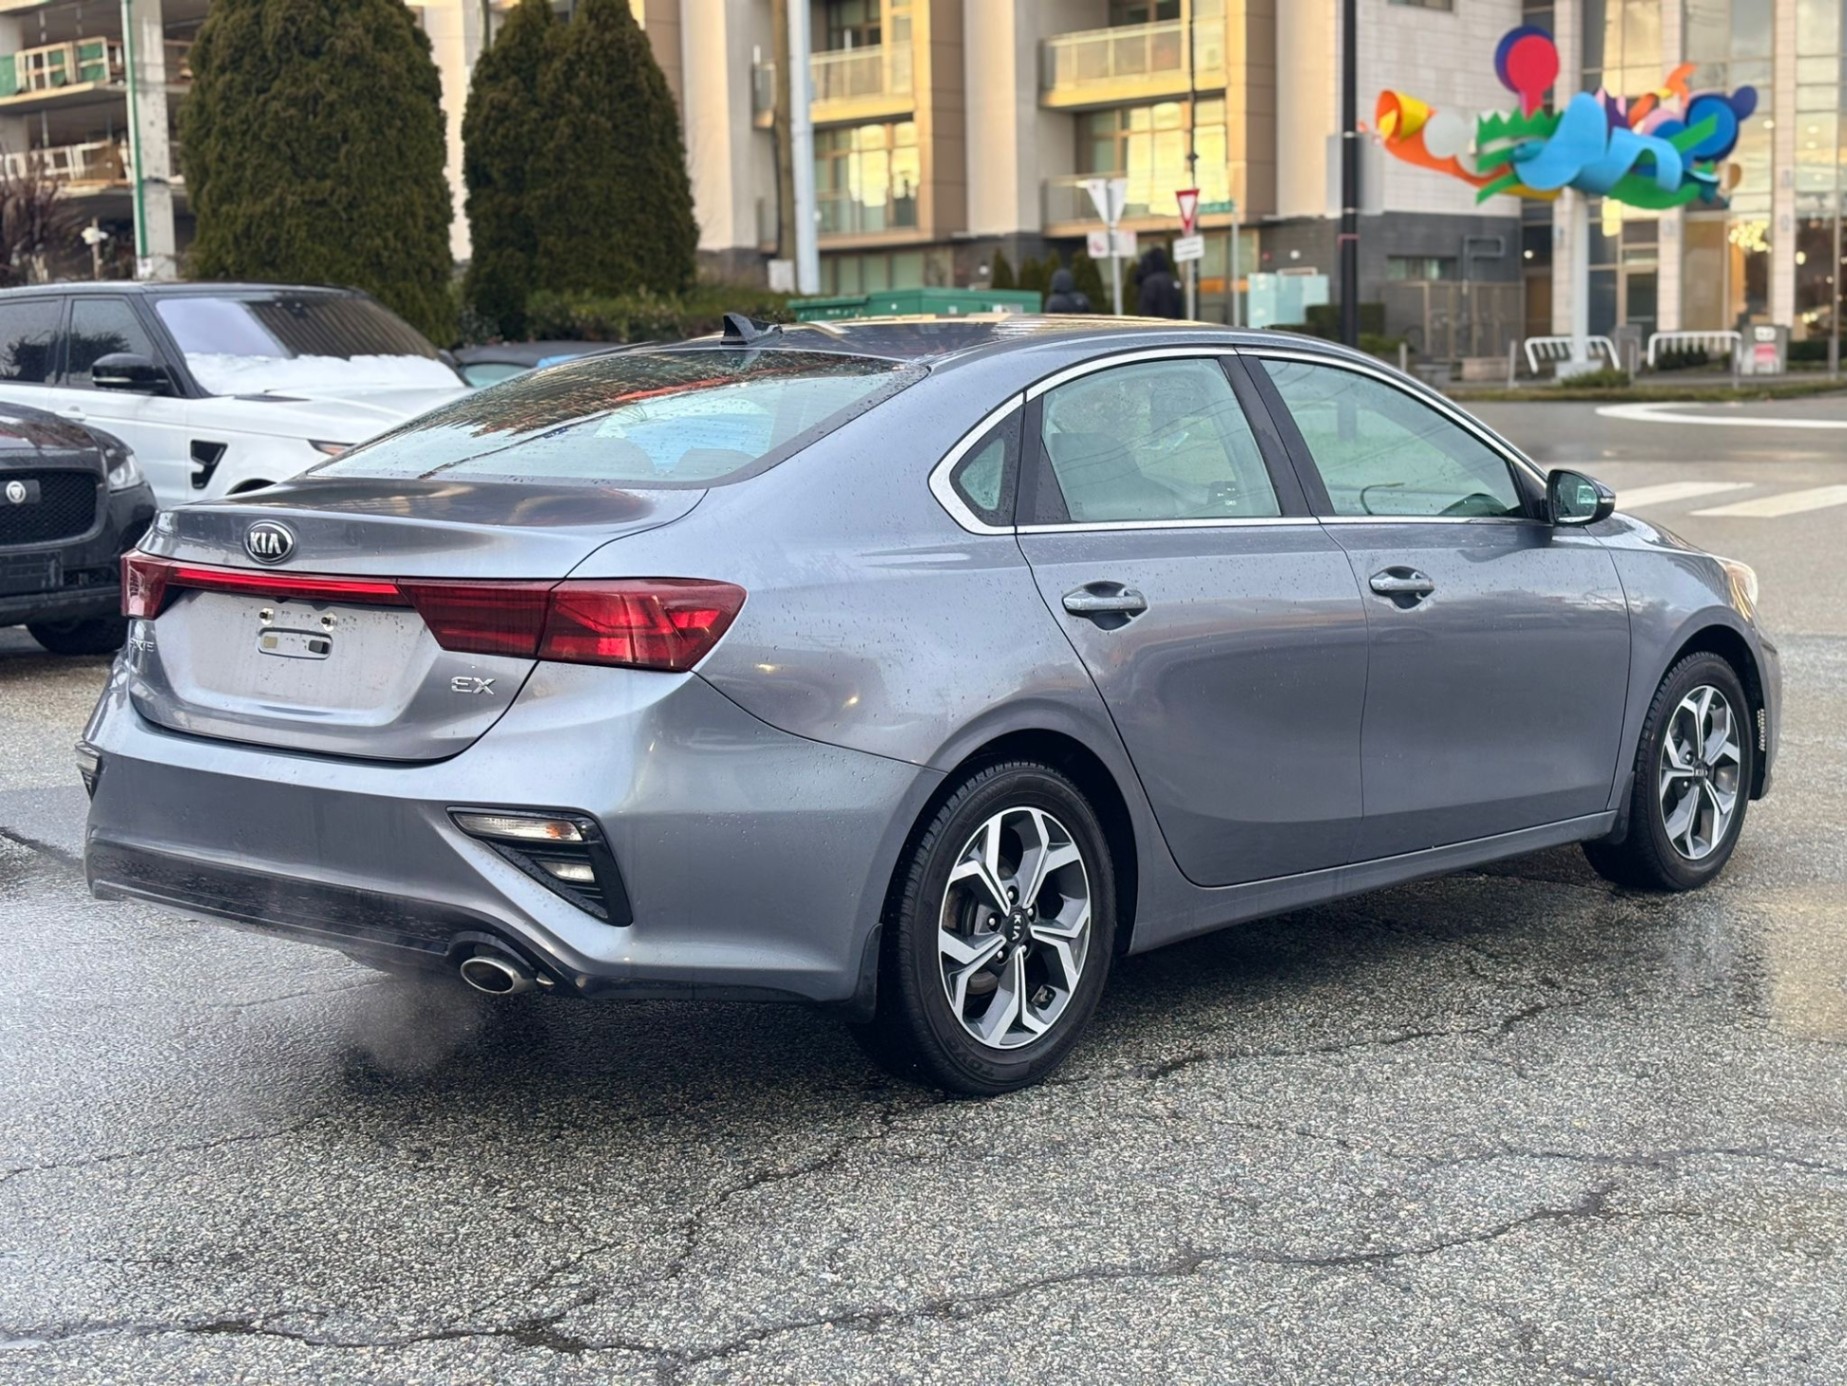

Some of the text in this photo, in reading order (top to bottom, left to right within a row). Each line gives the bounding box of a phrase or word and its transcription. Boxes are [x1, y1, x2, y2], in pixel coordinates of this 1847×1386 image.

[249, 531, 282, 554] KIA
[451, 676, 496, 695] EX
[1011, 914, 1022, 940] KIA
